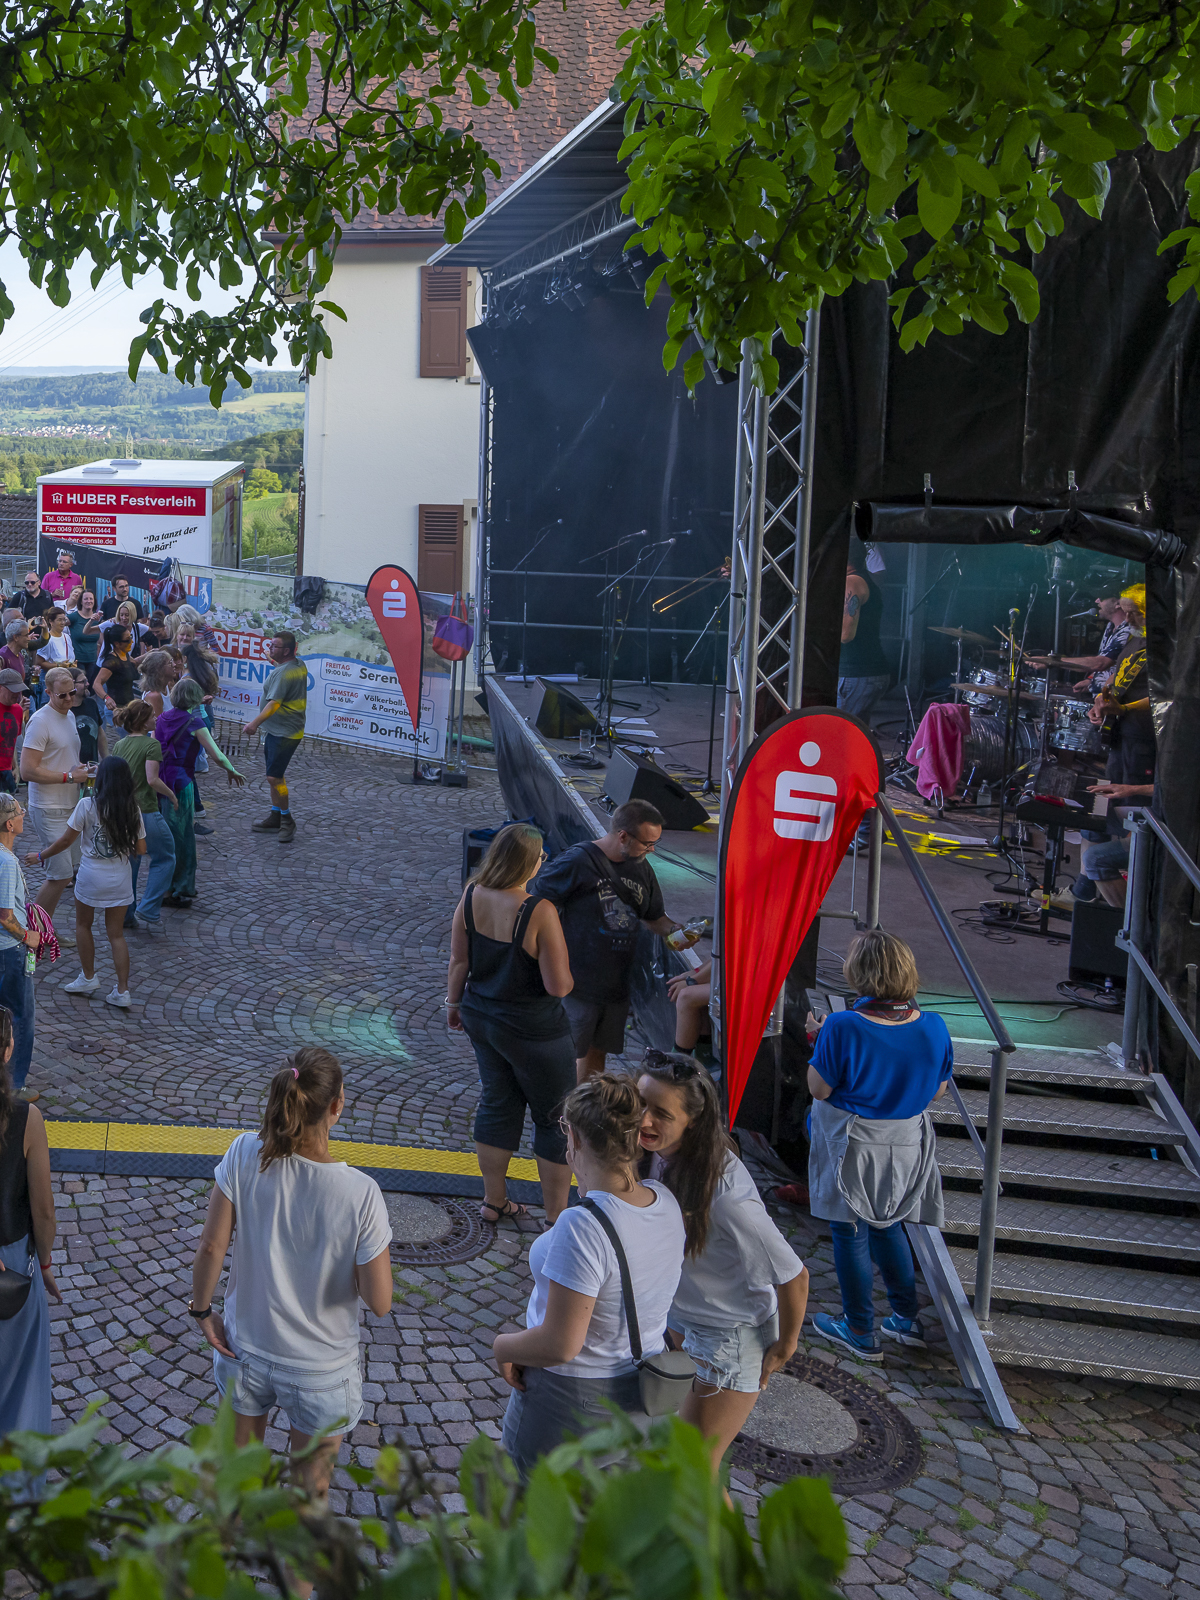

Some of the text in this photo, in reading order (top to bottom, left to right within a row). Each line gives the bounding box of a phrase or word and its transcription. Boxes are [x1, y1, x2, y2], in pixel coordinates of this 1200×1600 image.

[67, 493, 196, 507] HUBER Festverleih
[162, 530, 182, 541] tanzt
[183, 525, 198, 535] der
[214, 631, 272, 660] RFFES
[325, 661, 351, 671] FREITAG
[325, 668, 352, 677] 19:00 Uhr
[359, 667, 401, 684] Seren
[330, 688, 359, 699] SAMSTAG
[212, 705, 246, 717] nfeld-wt.de
[371, 703, 411, 718] & Partyab
[334, 715, 364, 725] SONNTAG
[370, 722, 430, 746] Dorfhock
